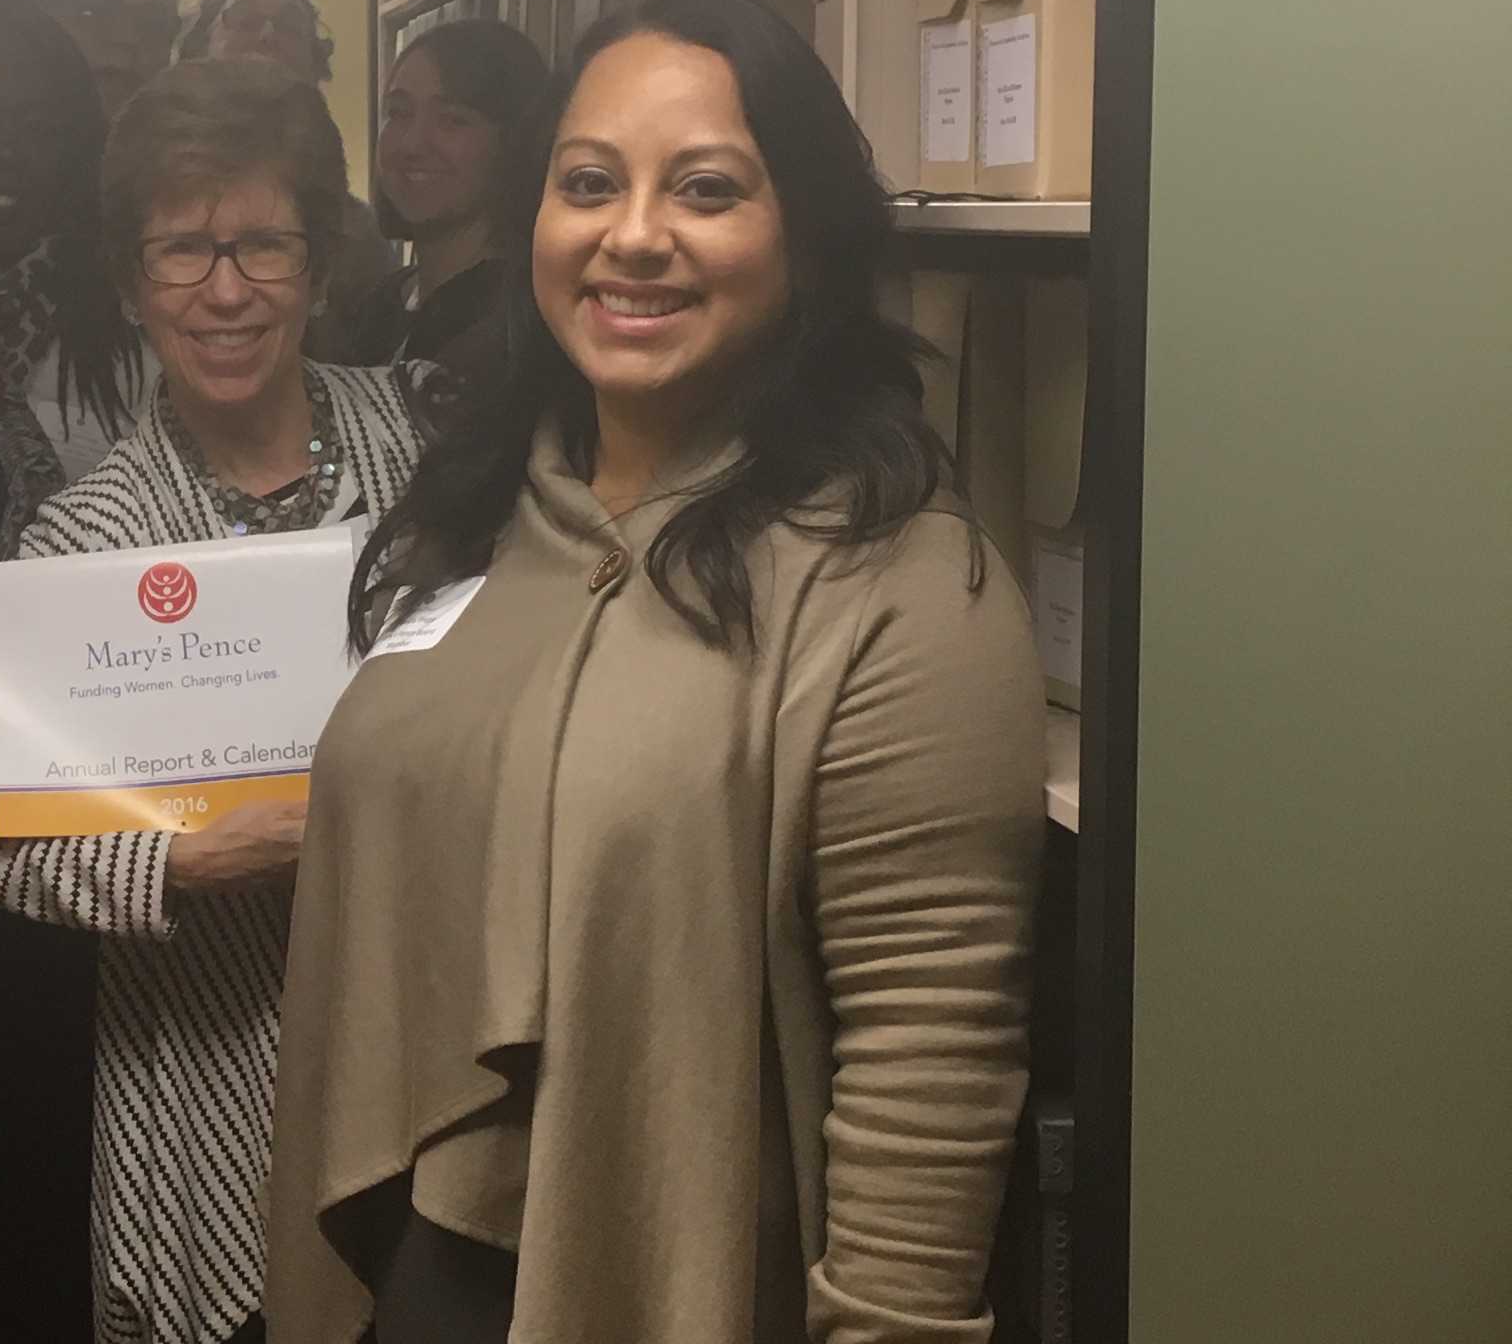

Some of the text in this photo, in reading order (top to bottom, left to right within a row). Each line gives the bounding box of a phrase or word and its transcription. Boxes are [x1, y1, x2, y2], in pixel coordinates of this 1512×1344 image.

[85, 631, 262, 671] Mary's Pence
[69, 668, 281, 698] Funding Women. Changing Lives.
[45, 740, 316, 779] Annual Report & Calendar
[160, 796, 209, 816] 2016
